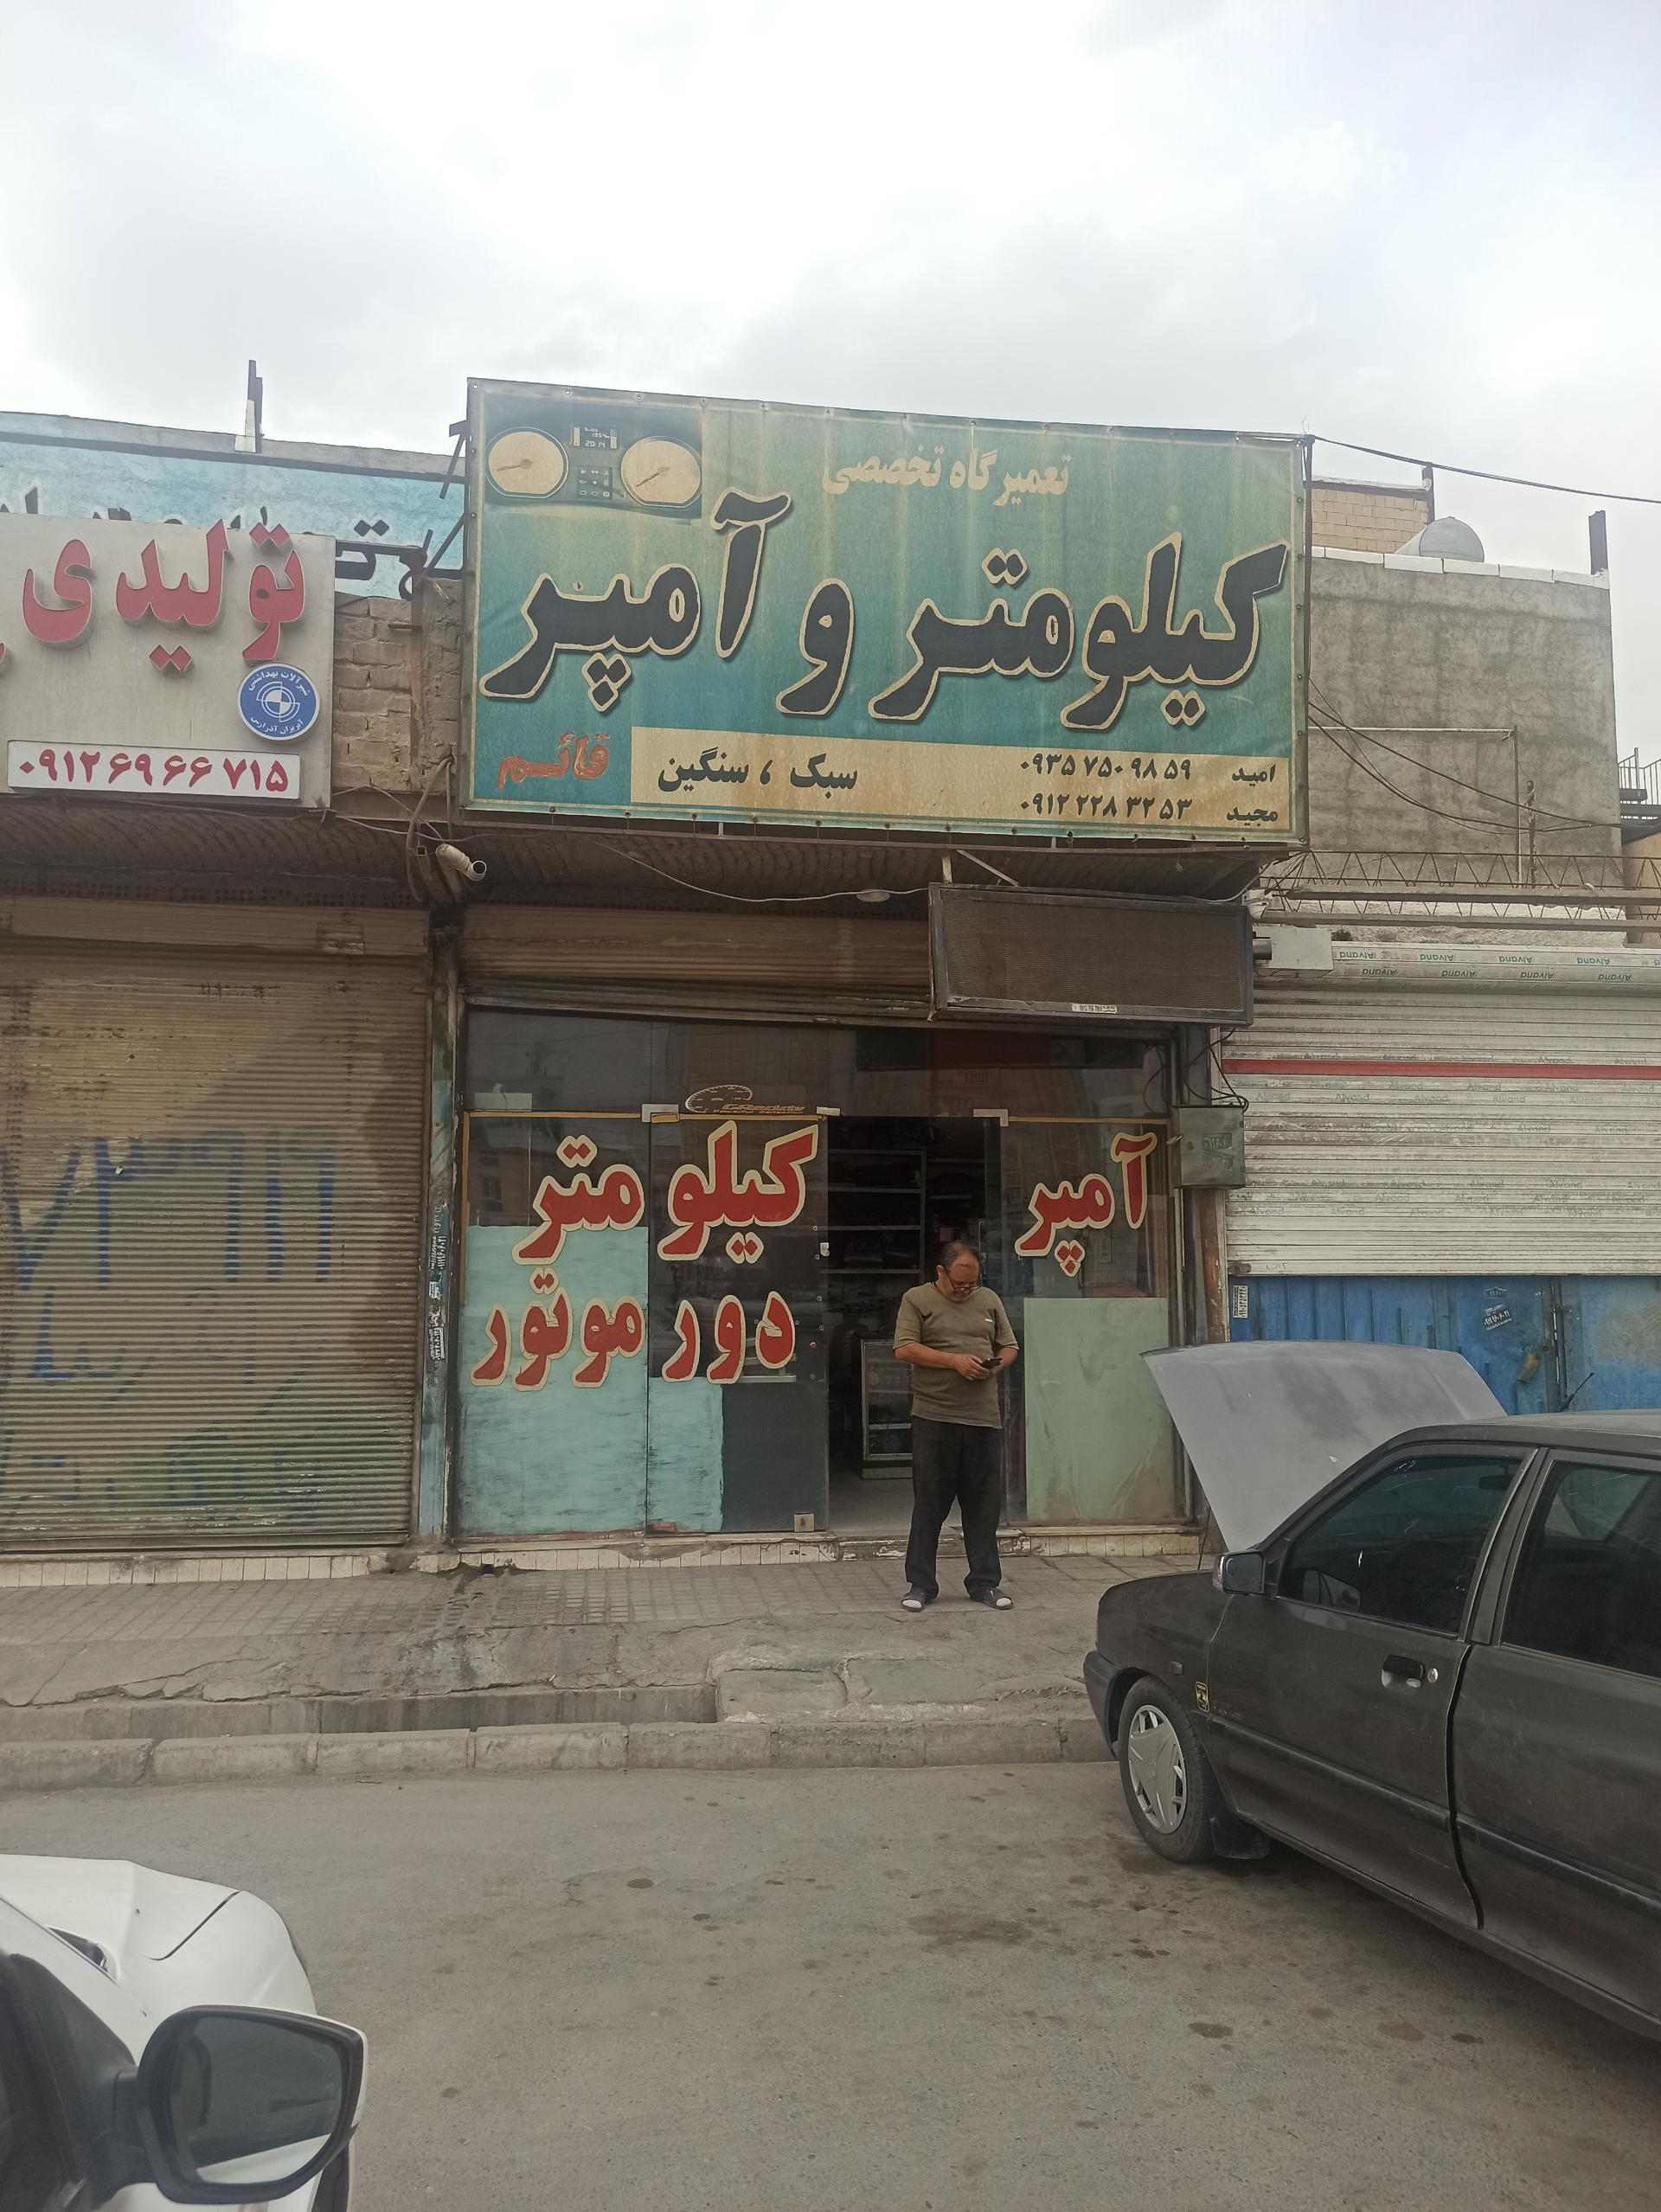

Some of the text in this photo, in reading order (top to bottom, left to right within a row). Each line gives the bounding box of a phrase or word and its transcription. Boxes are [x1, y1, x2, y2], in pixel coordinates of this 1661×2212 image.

[822, 443, 946, 495] تخصصی
[22, 518, 306, 671] تولیدی
[479, 486, 792, 714] آمپر
[776, 577, 856, 717] و
[496, 731, 611, 792] قائم
[657, 746, 750, 793] سنگین
[789, 752, 858, 800] سبک
[1231, 763, 1278, 787] امید
[1226, 805, 1279, 827] مجید
[1015, 1132, 1158, 1278] آمپر
[471, 1267, 795, 1391] دور موتور
